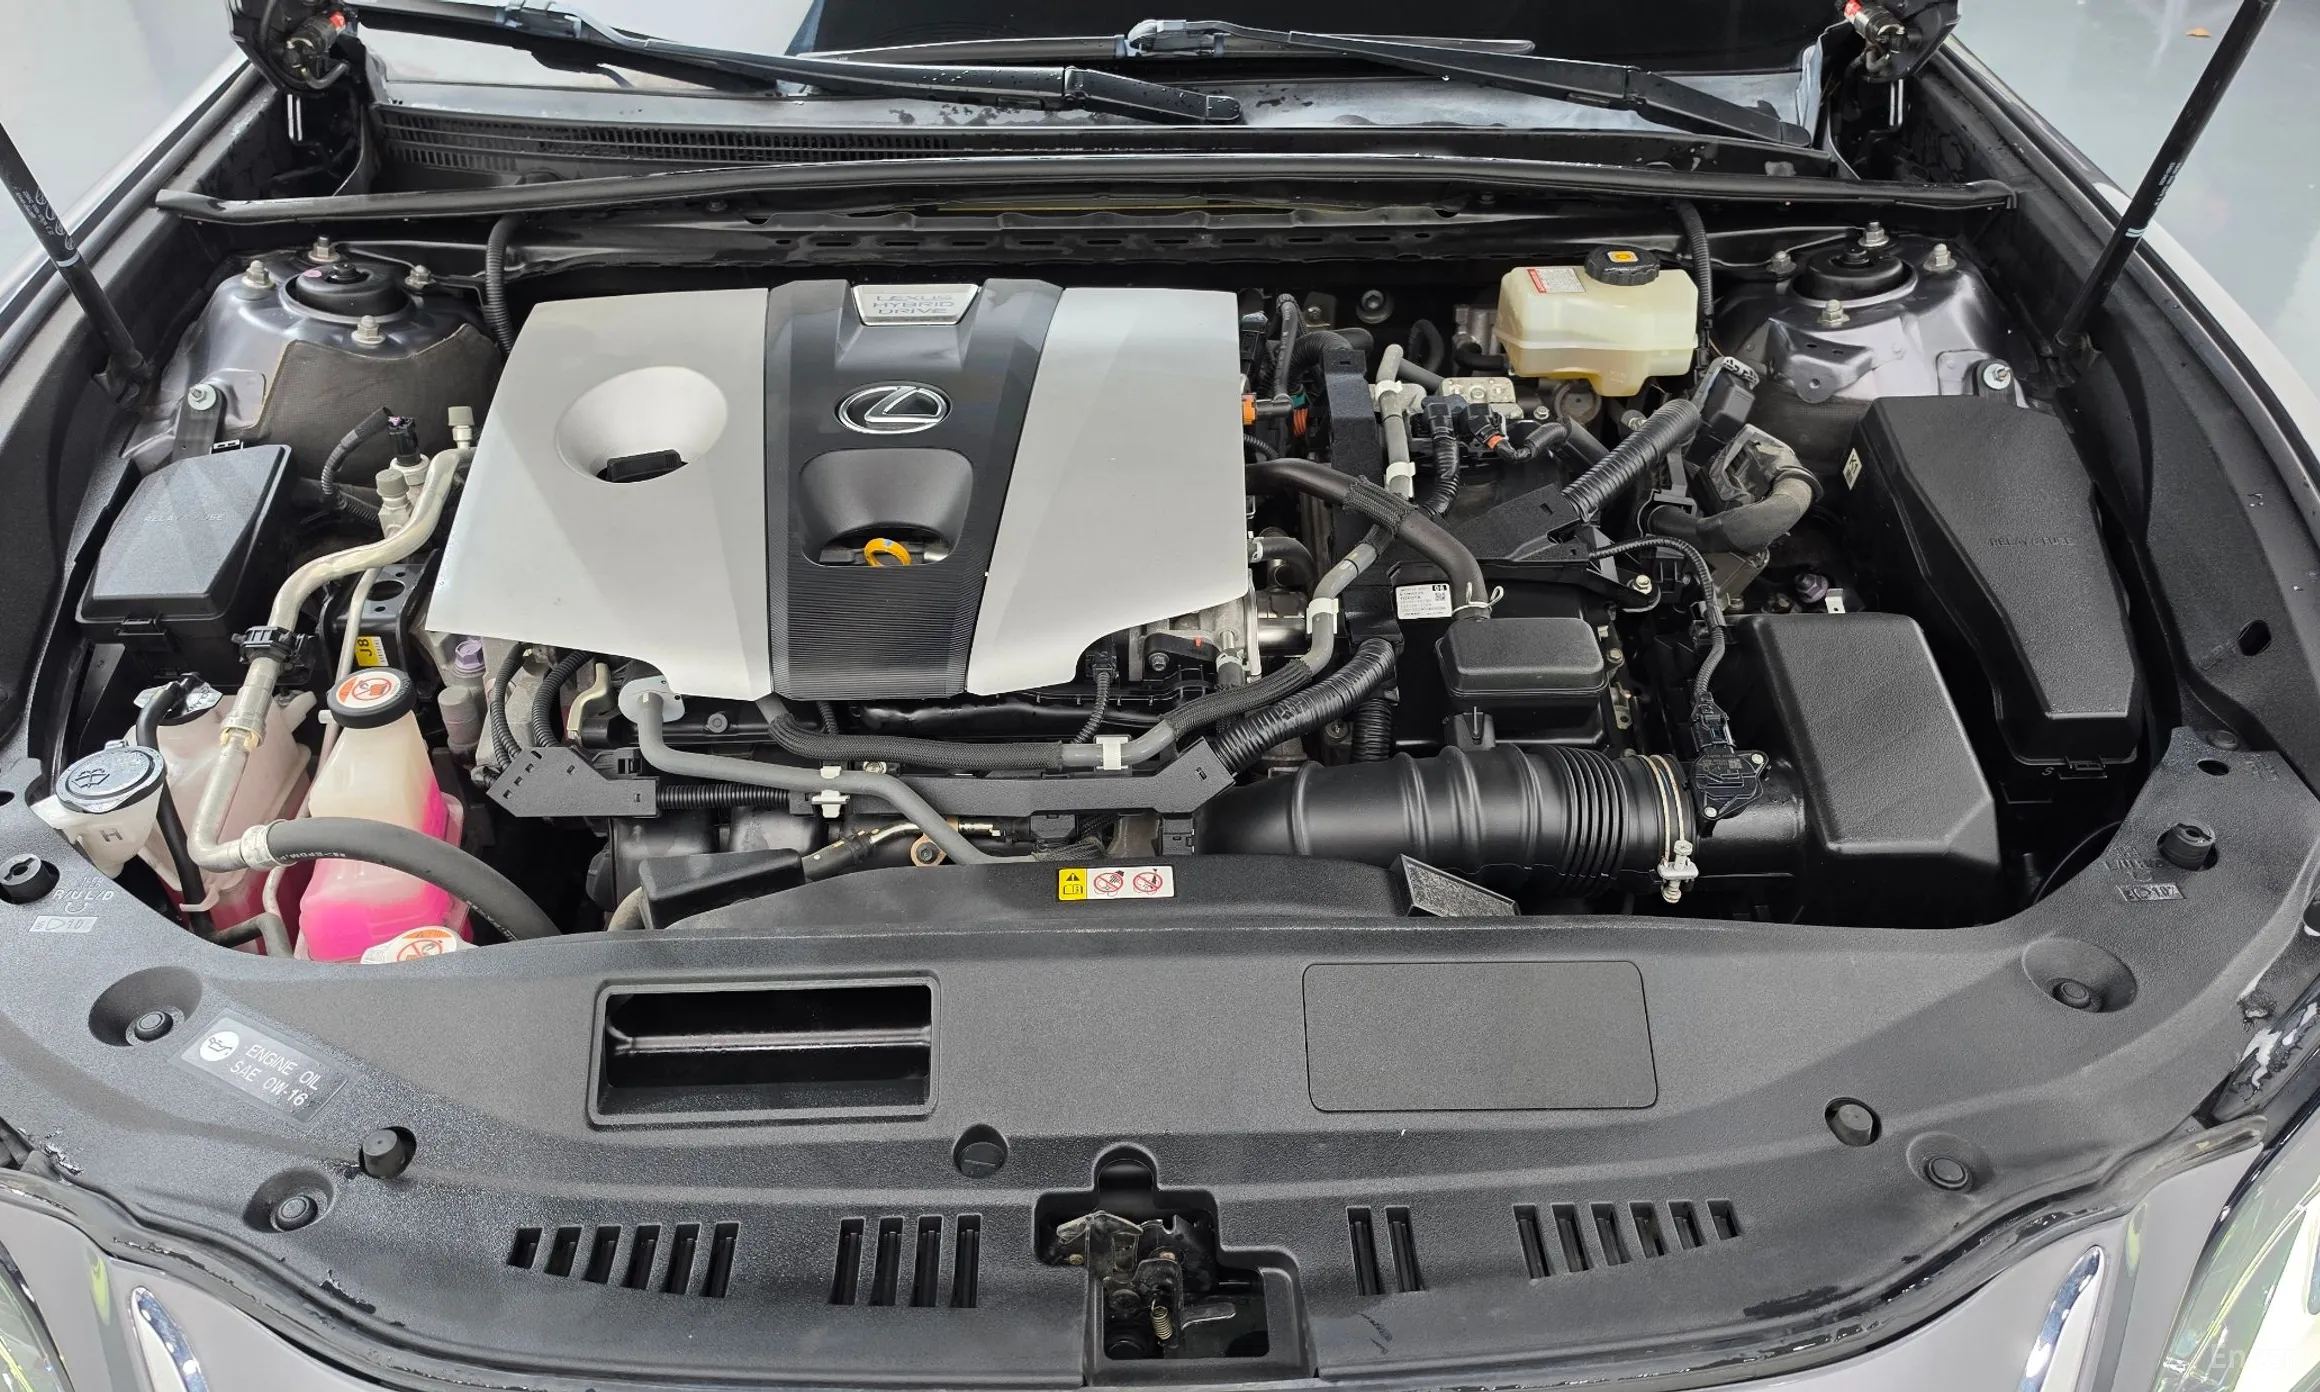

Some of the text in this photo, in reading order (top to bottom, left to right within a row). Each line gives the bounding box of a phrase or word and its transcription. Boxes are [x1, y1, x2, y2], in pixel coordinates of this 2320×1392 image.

[357, 639, 373, 656] J8
[52, 889, 114, 901] R/U L/D
[230, 1060, 262, 1082] SAE
[245, 1044, 322, 1091] ENGINE OIL
